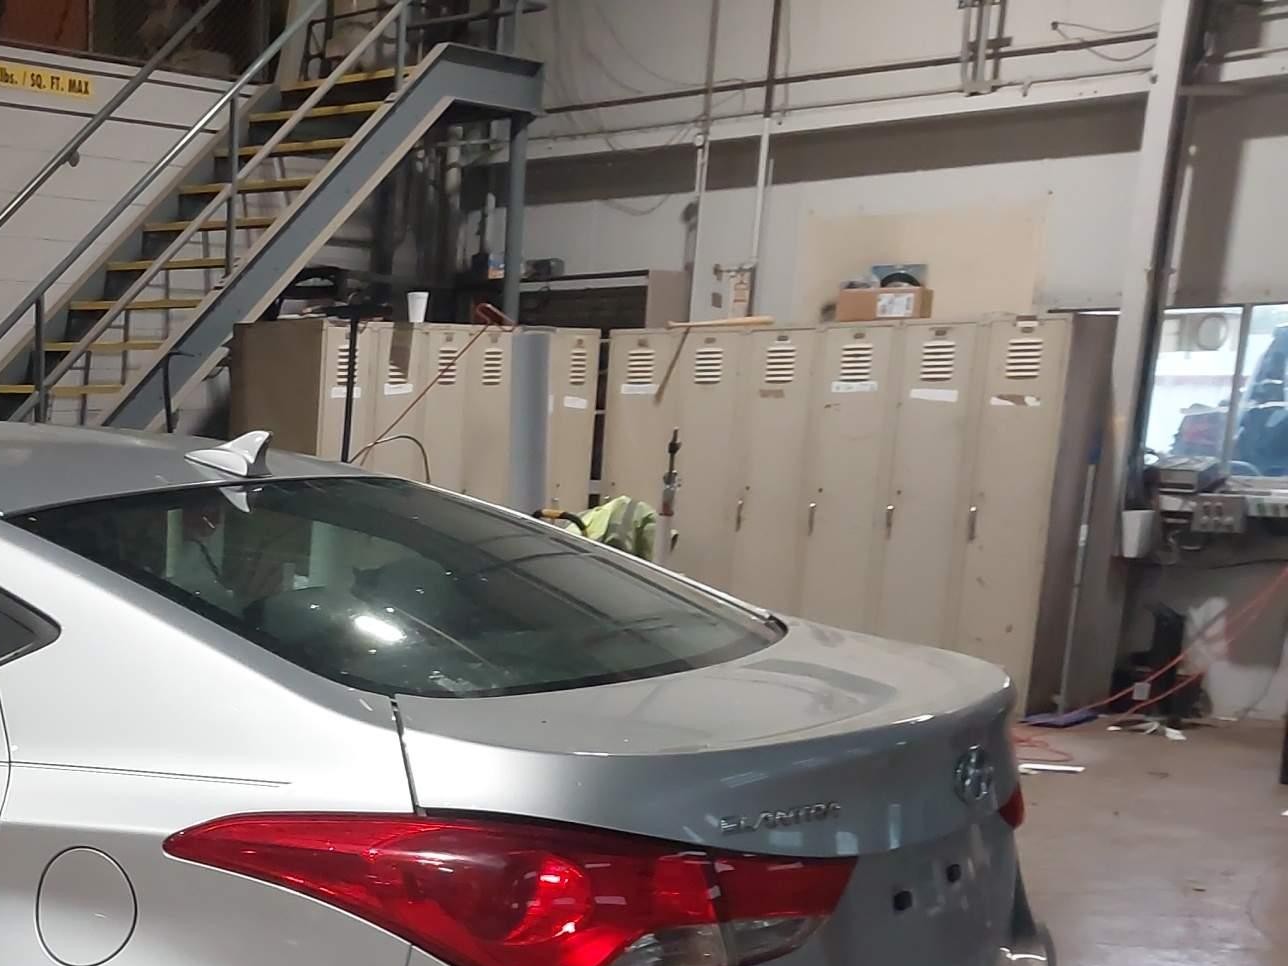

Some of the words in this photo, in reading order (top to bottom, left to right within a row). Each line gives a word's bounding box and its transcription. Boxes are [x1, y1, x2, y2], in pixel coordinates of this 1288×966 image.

[0, 67, 18, 85] lbs.
[30, 72, 46, 89] SQ.
[50, 75, 64, 92] FT.
[68, 78, 90, 95] MAX
